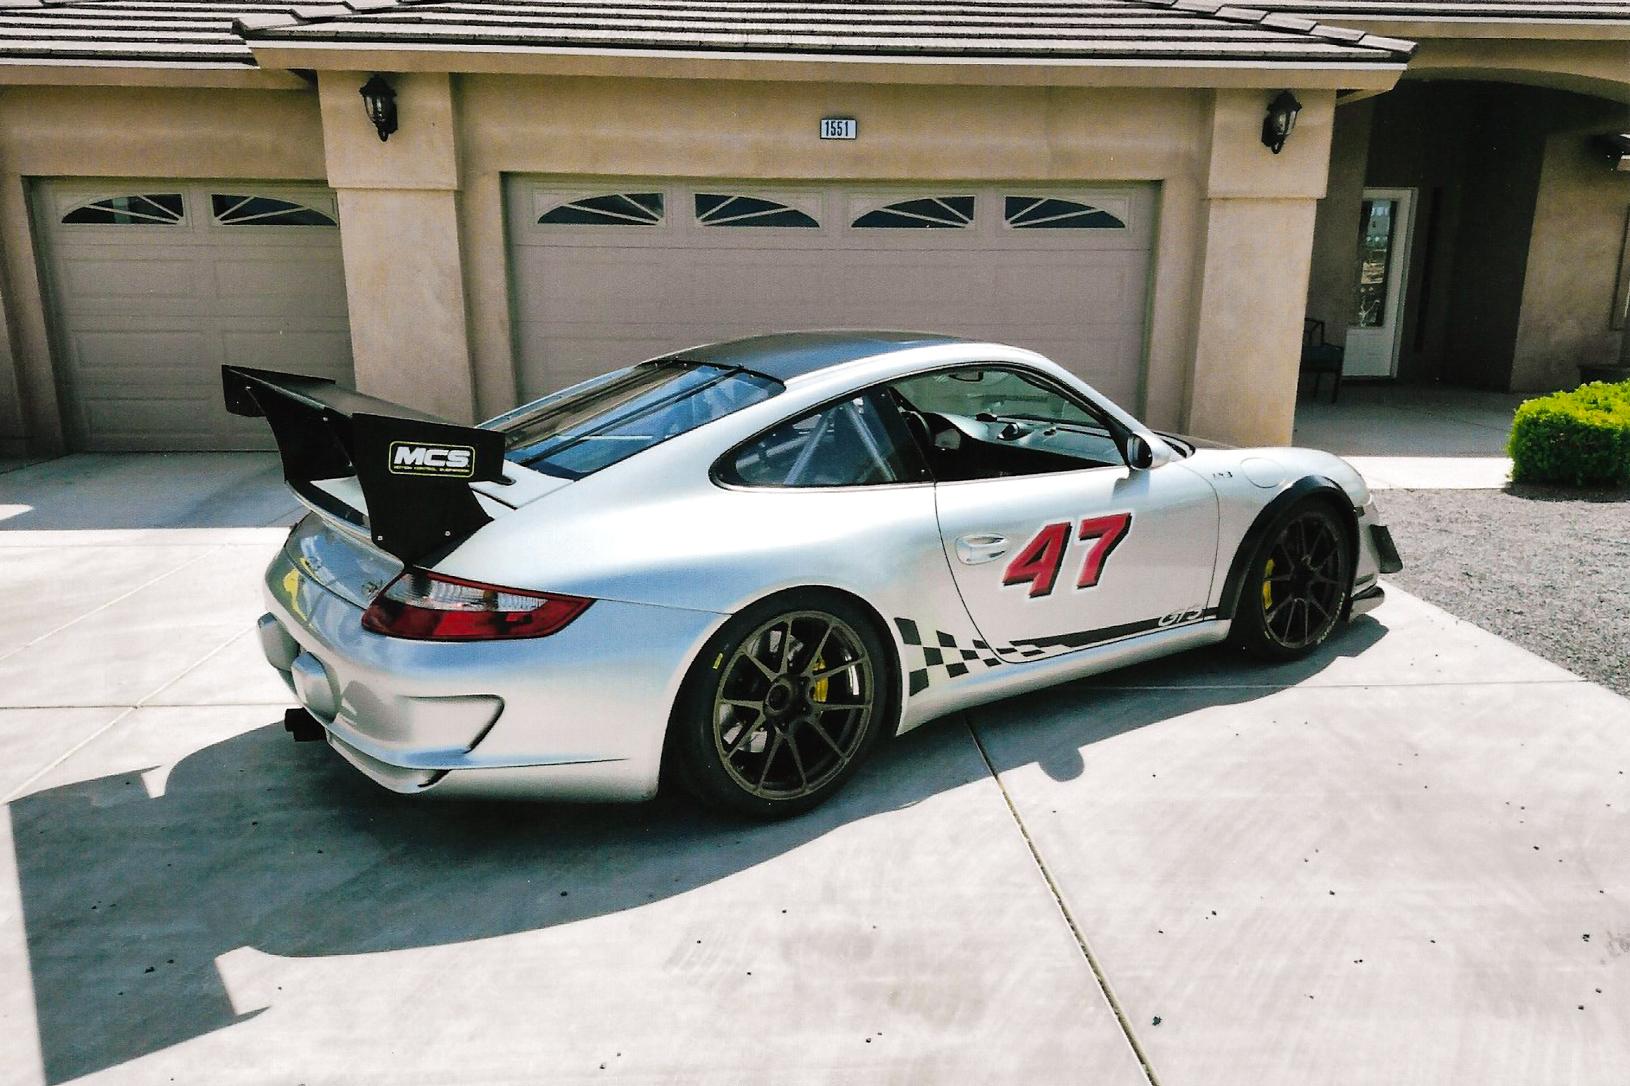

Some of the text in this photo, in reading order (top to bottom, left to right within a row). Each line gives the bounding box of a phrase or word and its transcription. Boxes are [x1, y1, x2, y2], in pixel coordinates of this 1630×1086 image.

[825, 120, 849, 137] 1551
[393, 446, 471, 468] MCS
[1002, 511, 1133, 599] 47
